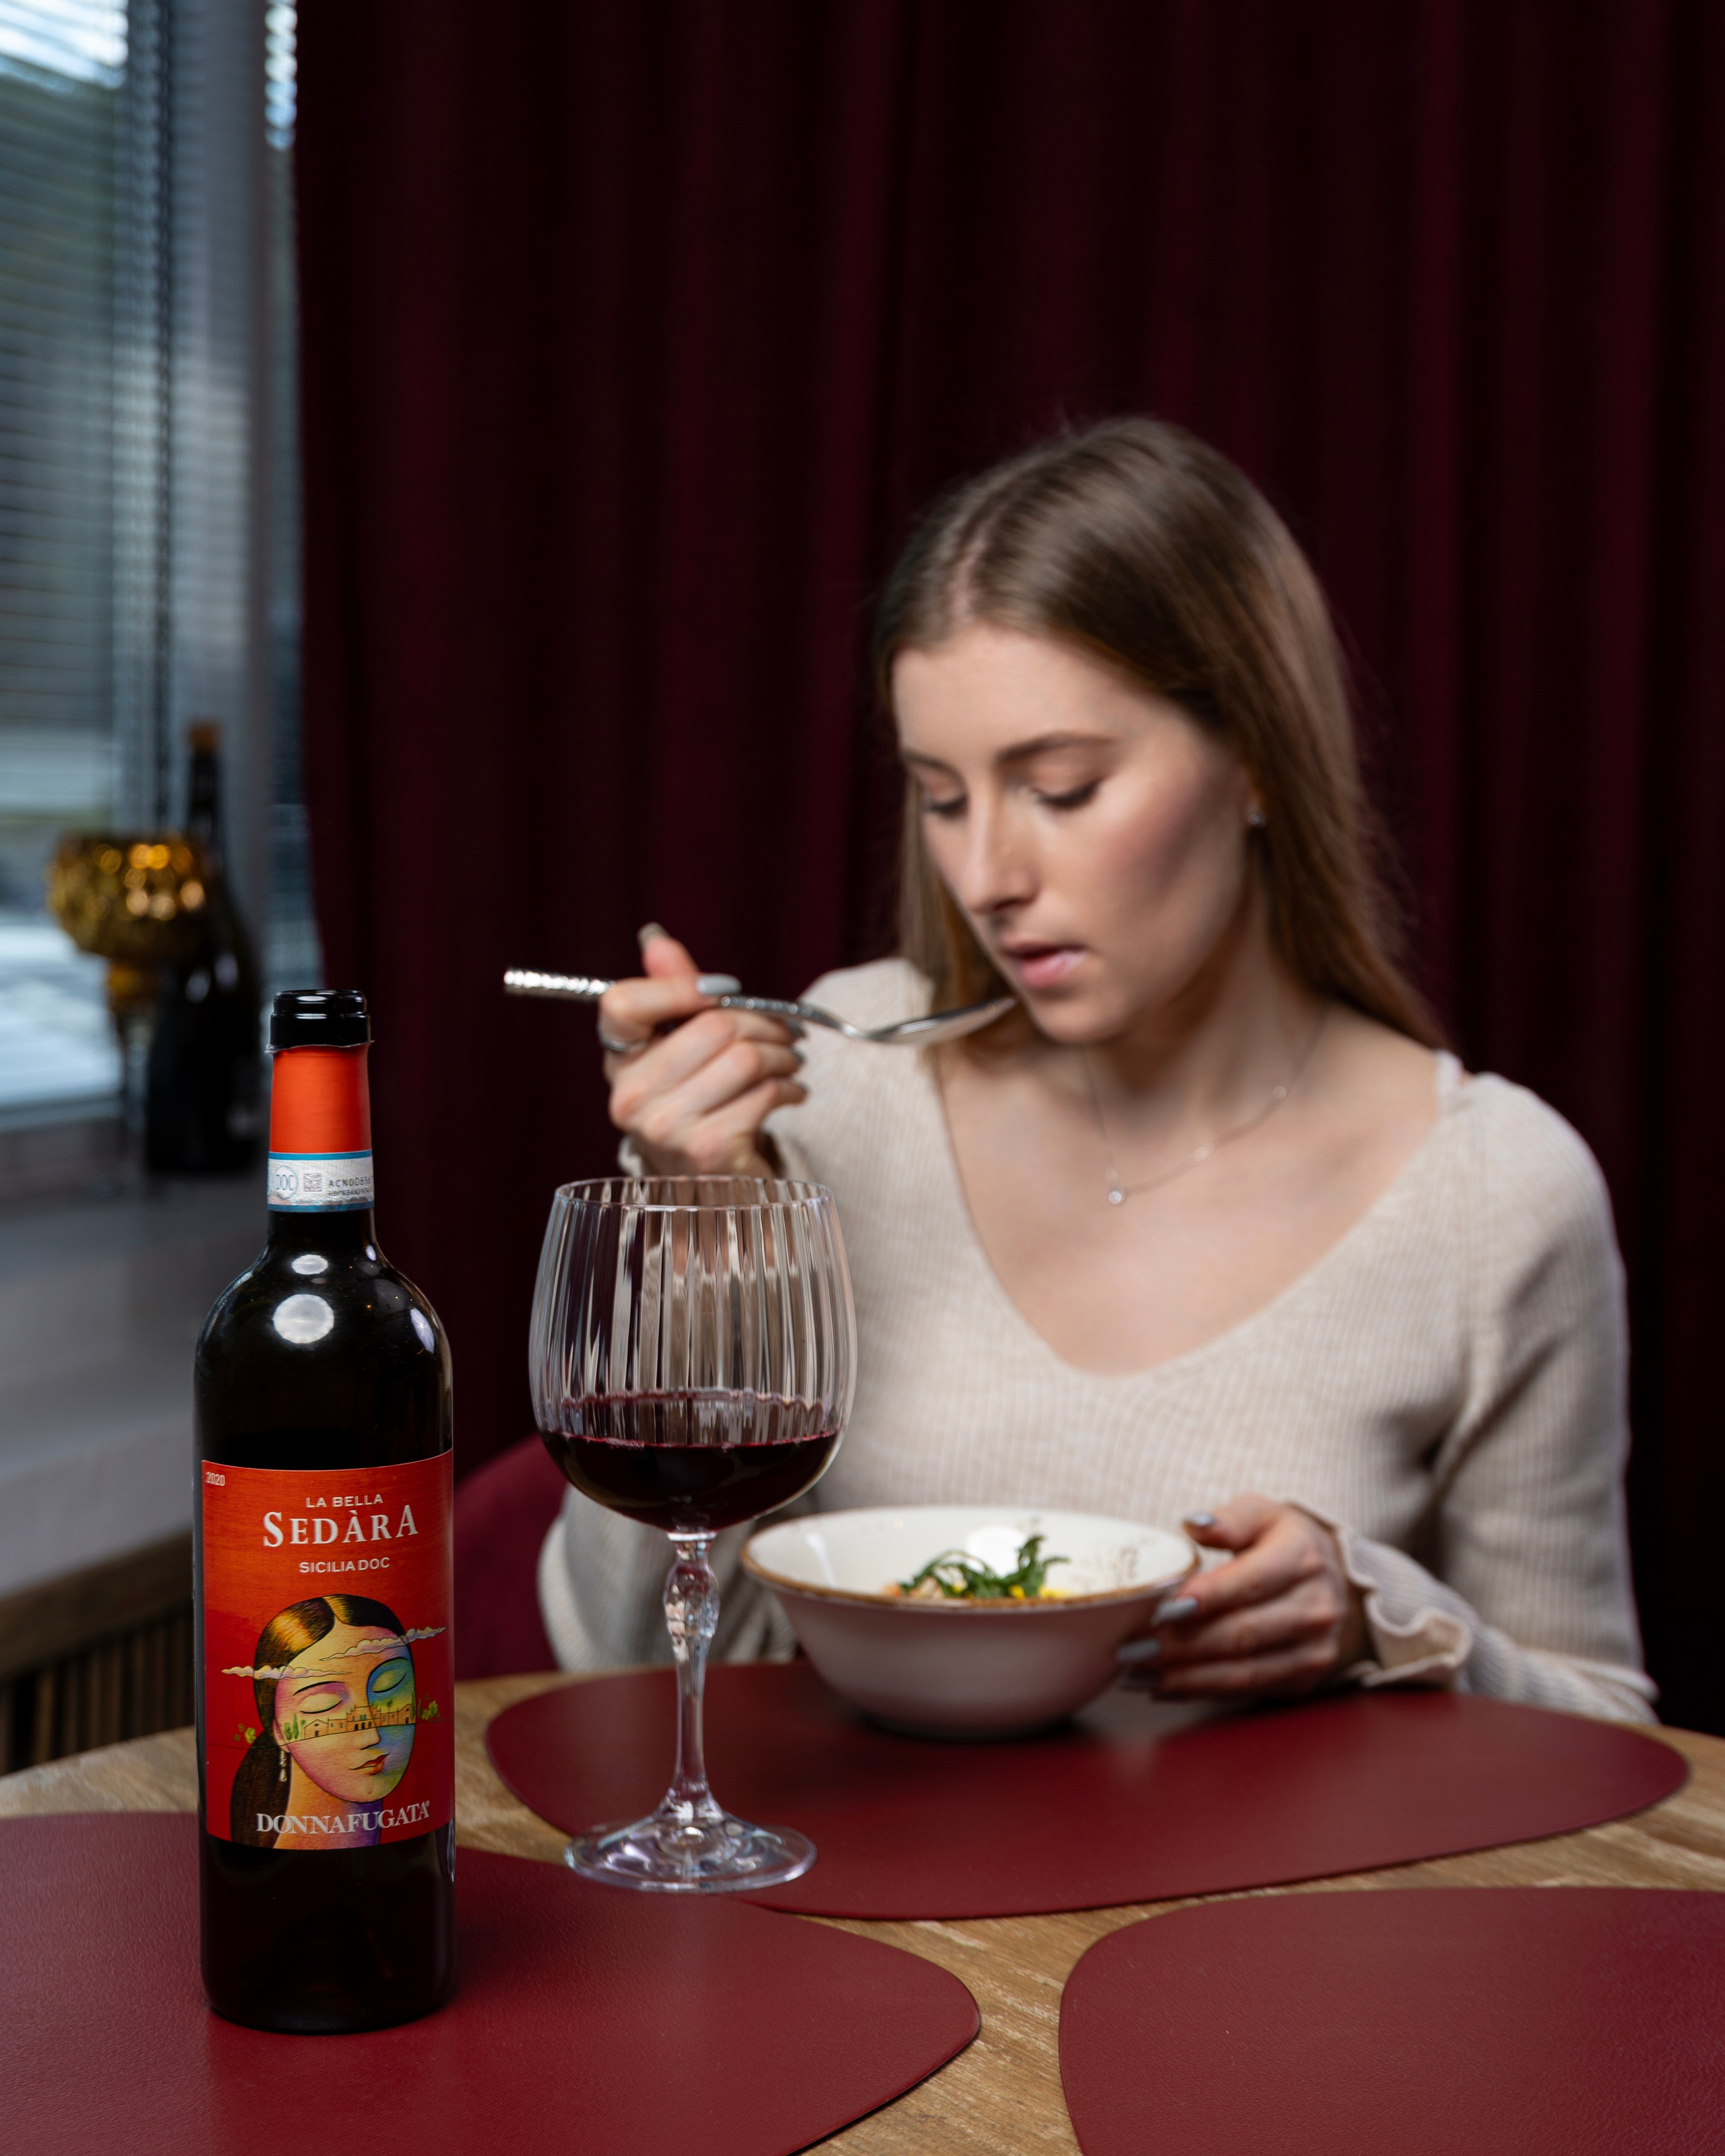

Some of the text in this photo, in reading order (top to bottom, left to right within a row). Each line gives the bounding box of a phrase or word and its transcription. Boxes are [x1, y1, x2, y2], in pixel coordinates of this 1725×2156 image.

[205, 1471, 225, 1486] 2020
[305, 1494, 383, 1508] LA BELLA
[263, 1504, 419, 1547] SEDÀRA
[299, 1557, 390, 1573] SICILIA DOC
